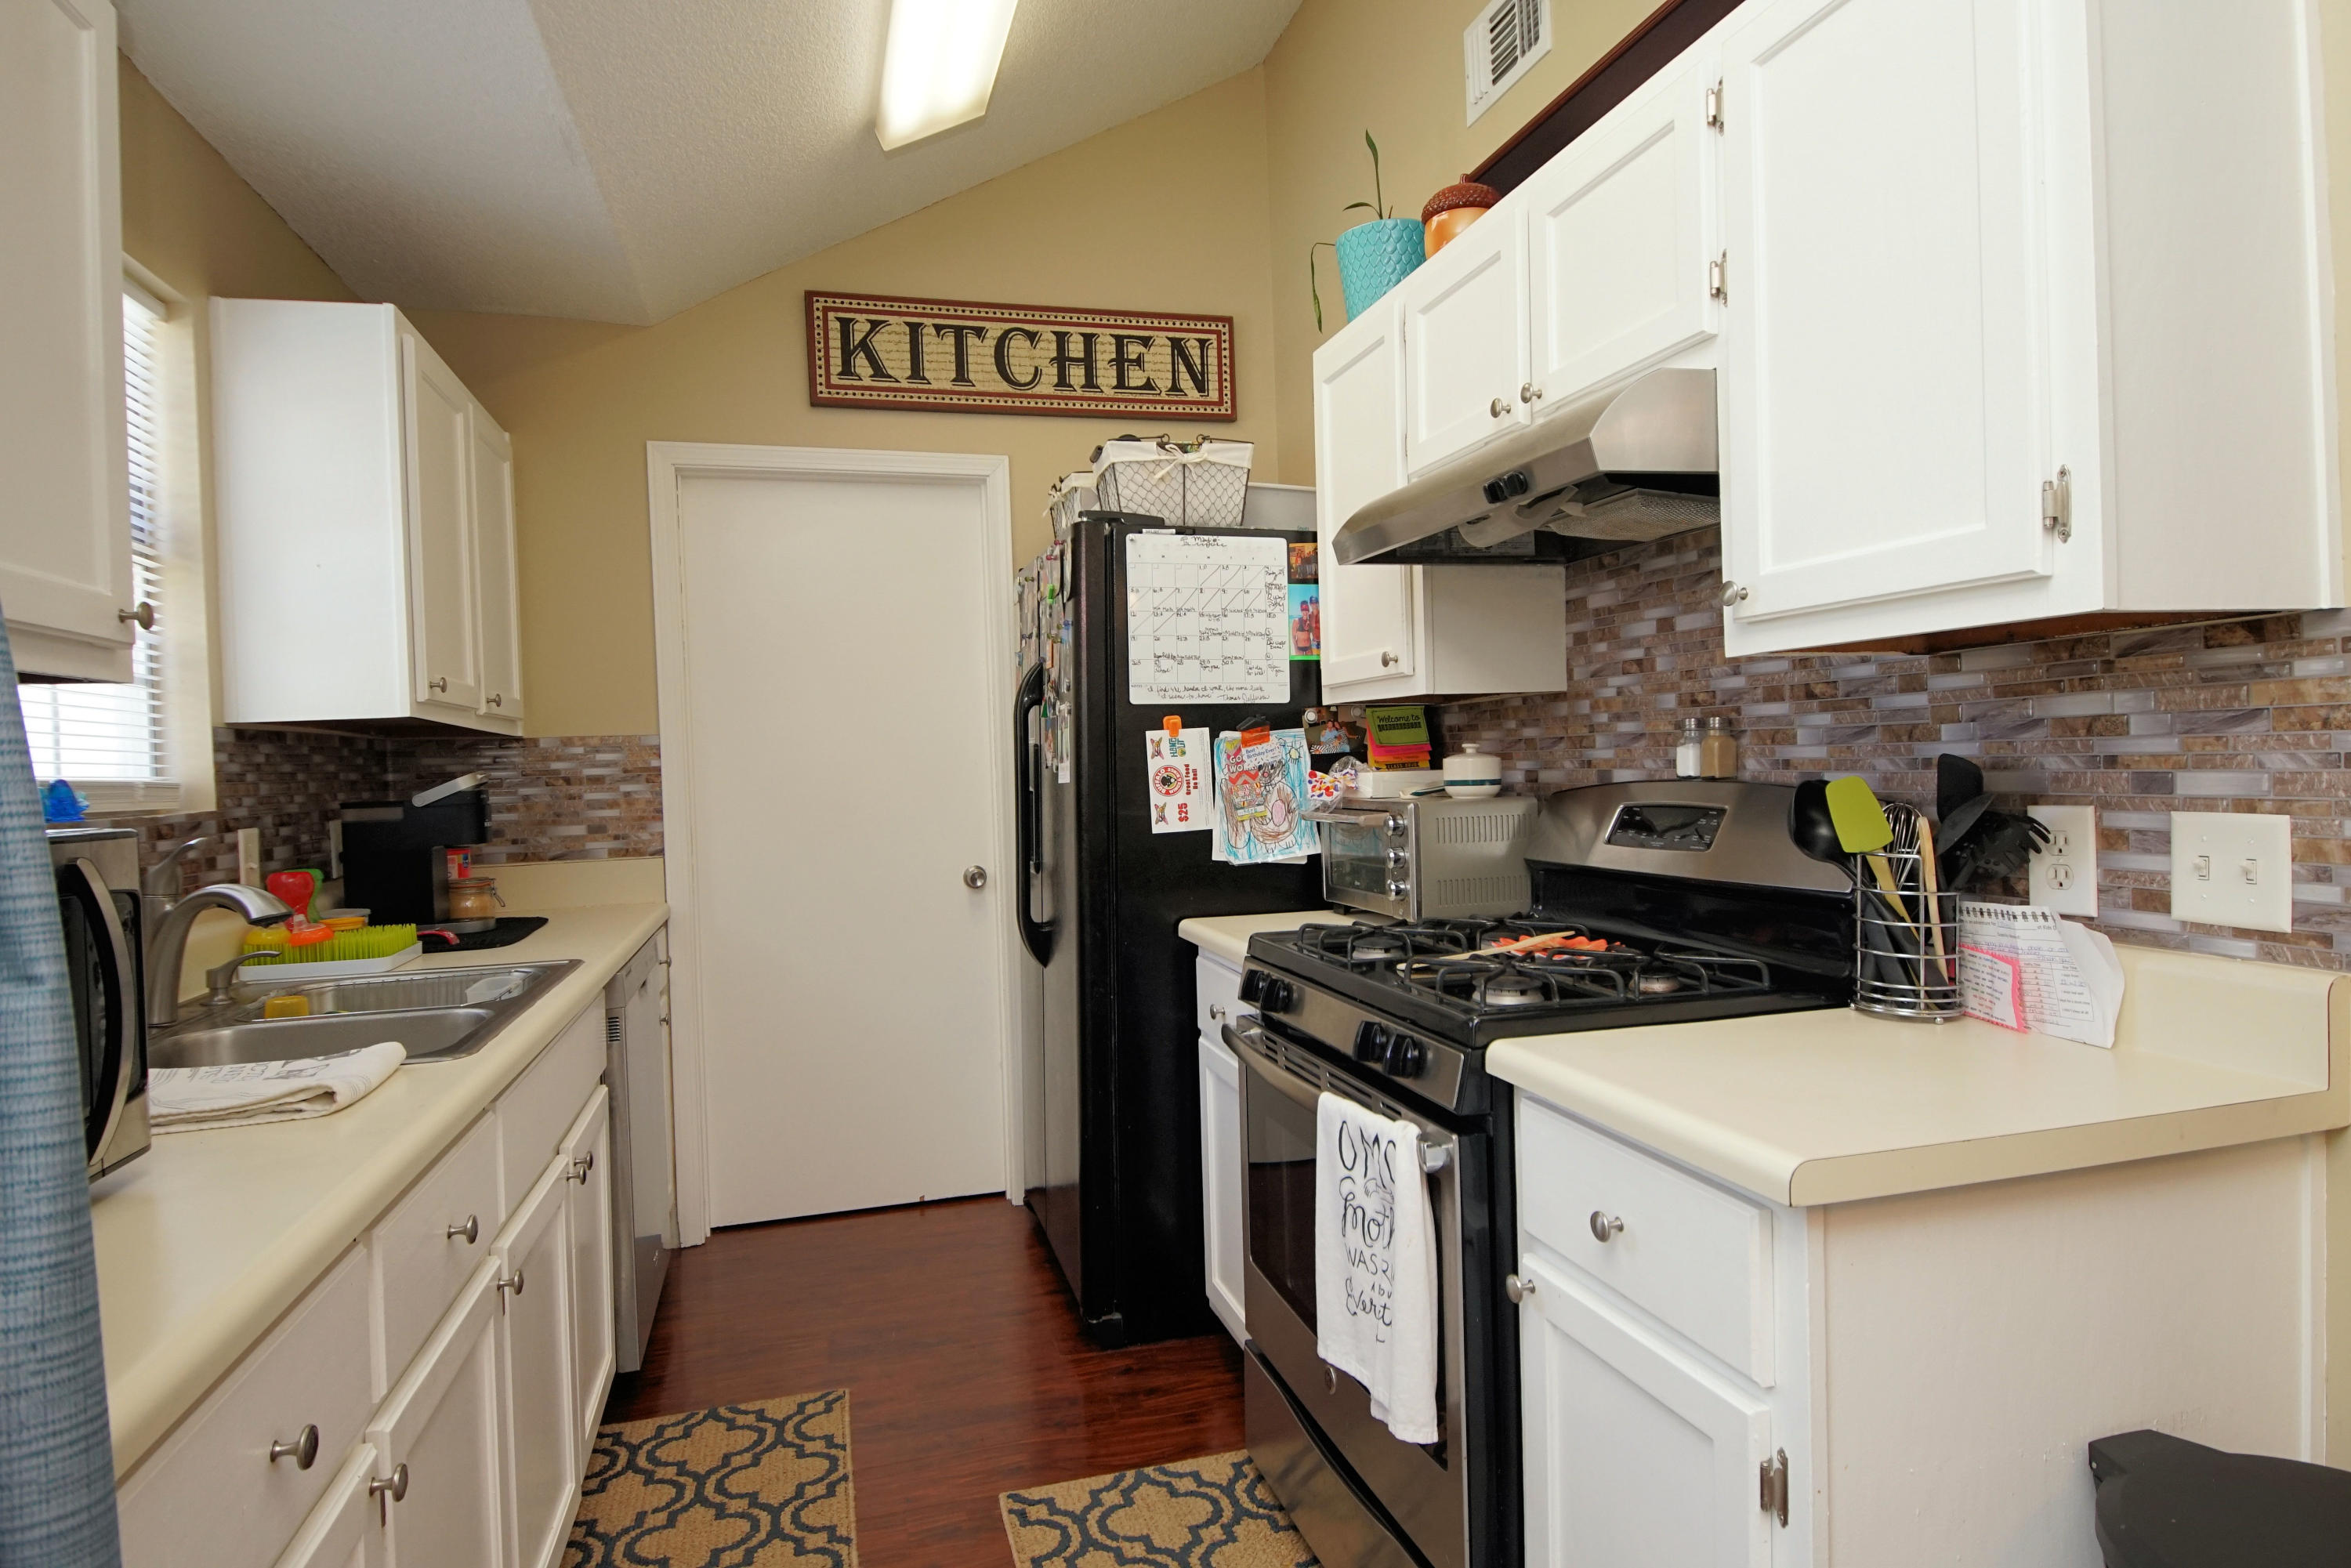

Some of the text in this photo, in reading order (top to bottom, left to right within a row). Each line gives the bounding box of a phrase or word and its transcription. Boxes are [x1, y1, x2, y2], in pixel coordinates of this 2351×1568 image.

[834, 316, 1214, 397] KITCHEN
[1168, 737, 1178, 758] HANG
[1230, 755, 1242, 763] GO
[1177, 802, 1190, 823] $25
